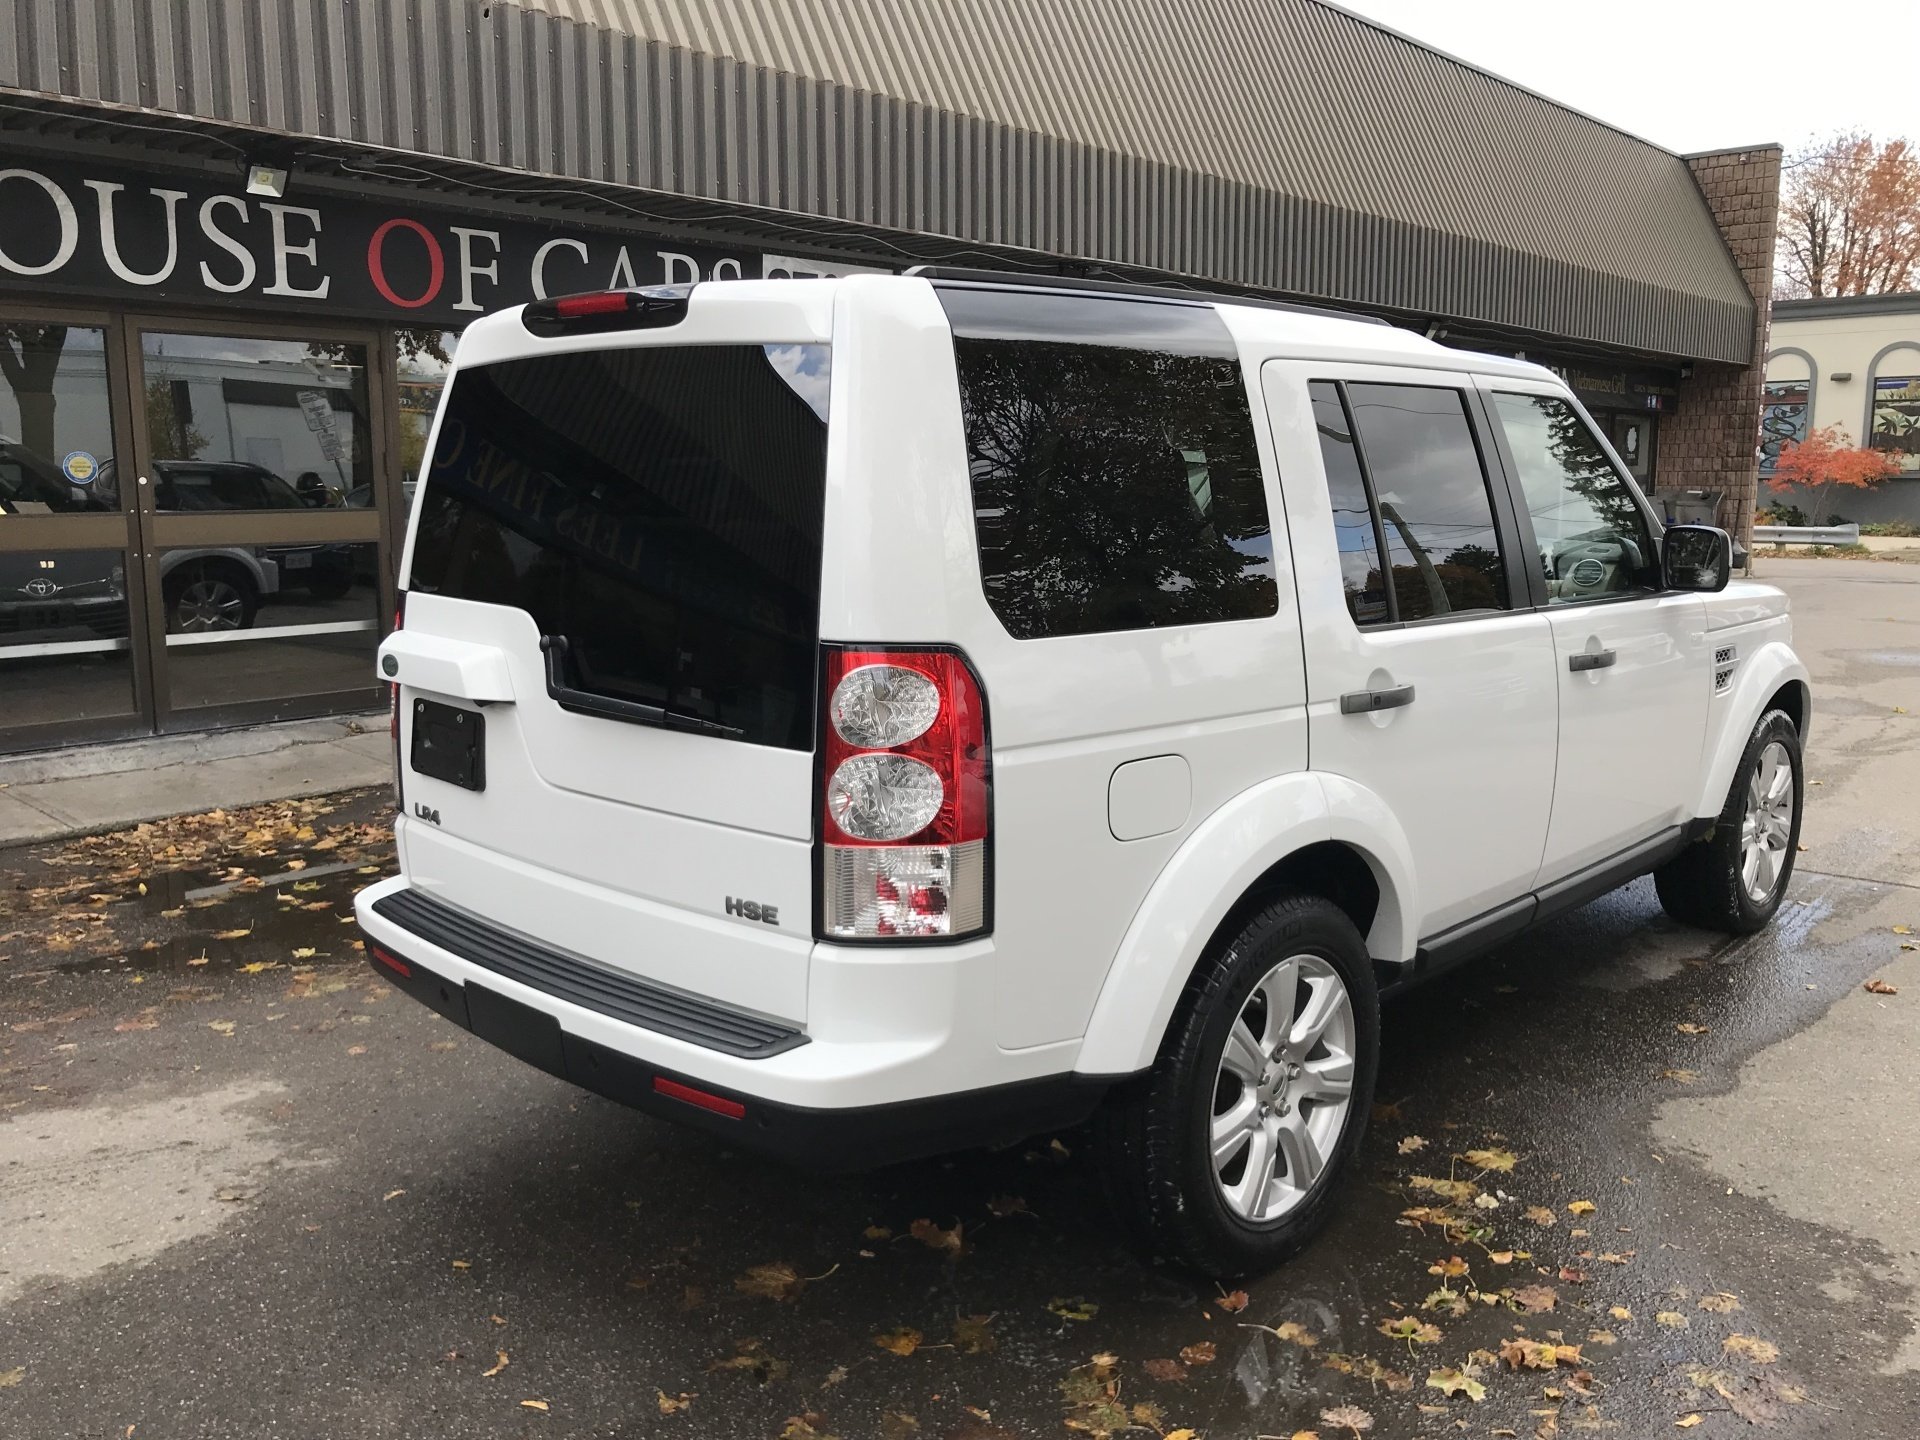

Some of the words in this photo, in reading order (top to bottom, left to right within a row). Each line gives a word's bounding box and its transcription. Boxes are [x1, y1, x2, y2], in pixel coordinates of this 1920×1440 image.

[367, 218, 501, 312] OF
[1755, 299, 1772, 457] ESPRESSO
[415, 802, 441, 826] LR4
[725, 895, 780, 926] HSE
